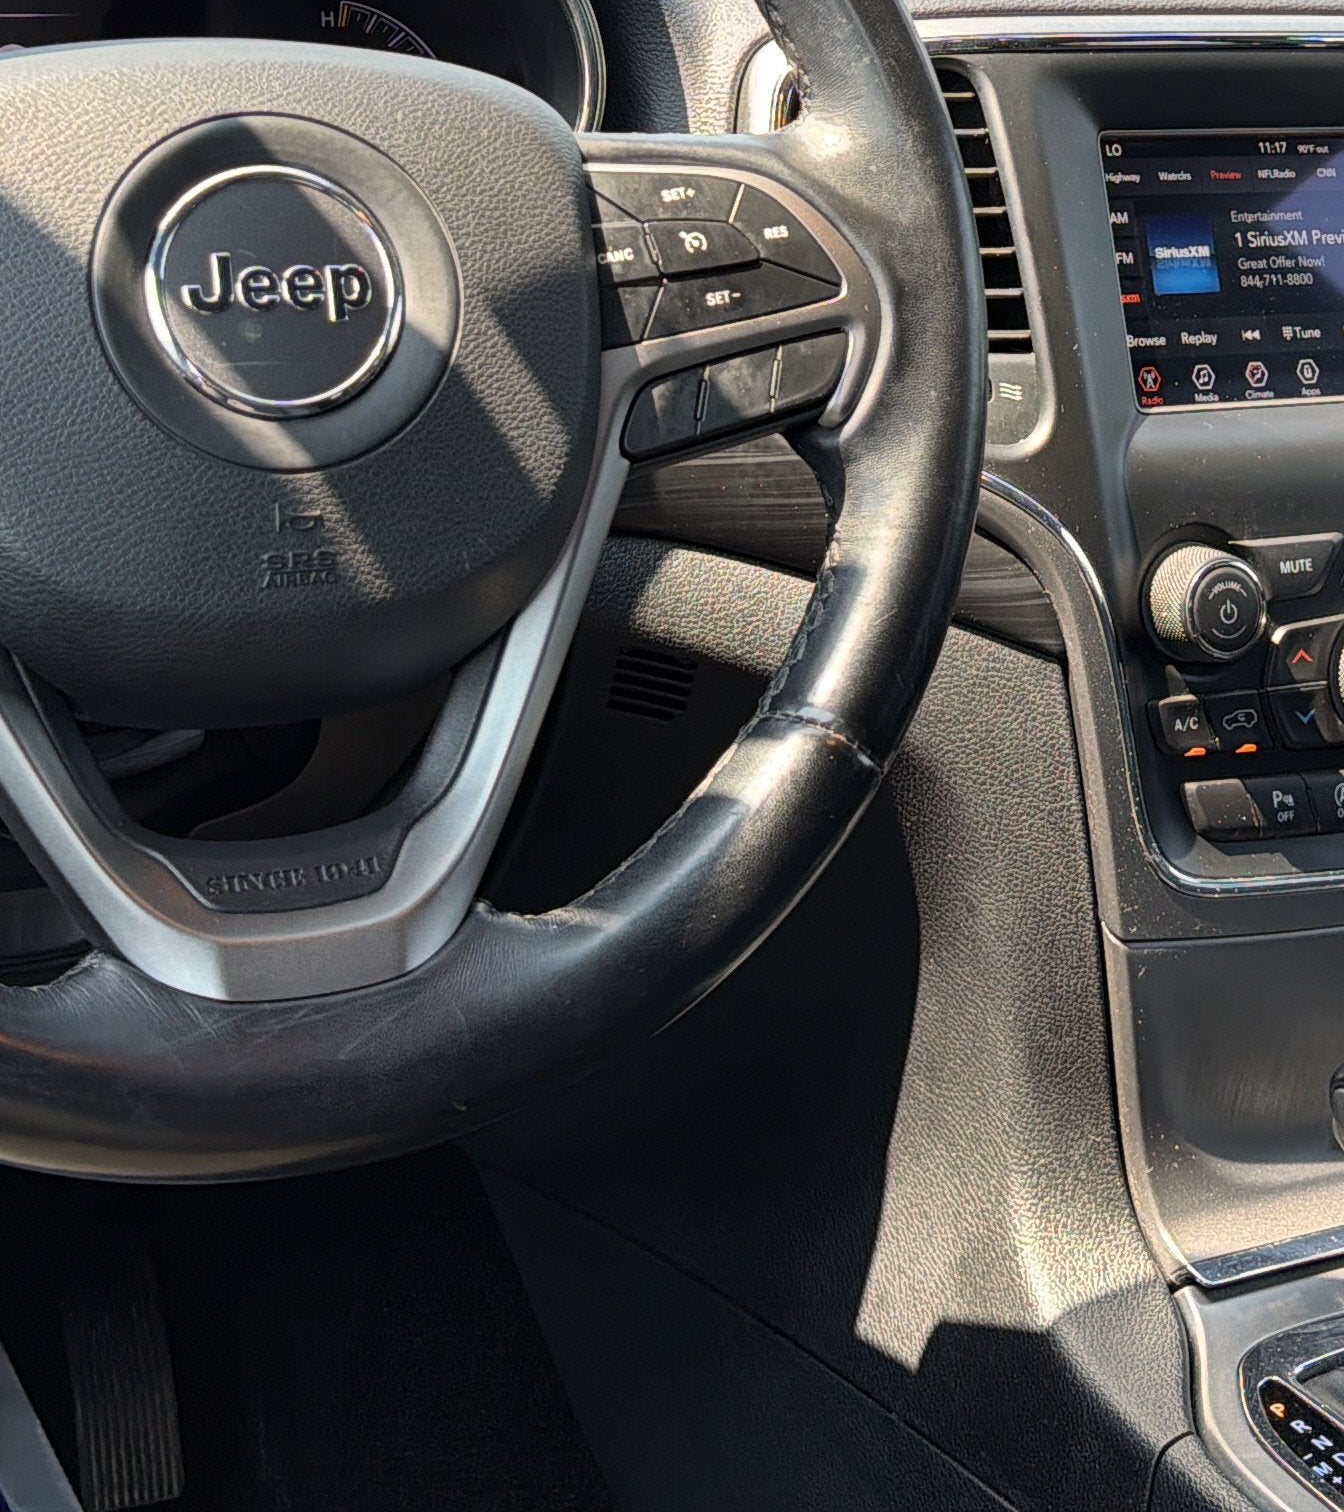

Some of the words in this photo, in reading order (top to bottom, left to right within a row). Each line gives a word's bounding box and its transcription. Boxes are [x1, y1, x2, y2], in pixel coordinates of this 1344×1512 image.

[320, 11, 335, 28] H
[1106, 143, 1122, 157] LO
[1258, 141, 1287, 154] 11:17
[1106, 171, 1141, 184] Highway
[1210, 170, 1243, 180] Preview
[1316, 167, 1336, 178] CNN
[1109, 211, 1129, 224] AM
[1230, 210, 1304, 224] Entertainment
[763, 225, 790, 240] RES
[1234, 232, 1243, 248] 1
[1247, 230, 1308, 248] SiriusXM
[597, 247, 635, 265] CANC
[1115, 252, 1134, 264] FM
[1154, 245, 1210, 259] SiriusXM
[1238, 257, 1268, 271] Great
[1269, 256, 1297, 268] Offer
[1298, 255, 1326, 268] Now!
[1240, 272, 1314, 288] 844-711-8800
[180, 251, 373, 324] Jeep
[1181, 330, 1218, 347] Replay
[1294, 326, 1322, 339] Tune
[1126, 335, 1167, 348] Browse
[1141, 396, 1164, 406] Radio
[1194, 393, 1219, 402] Media
[1245, 390, 1275, 400] Climate
[1279, 558, 1313, 575] MUTE
[1211, 579, 1243, 594] VOLUME
[1174, 716, 1199, 732] A/C
[1277, 810, 1295, 822] OFF
[1269, 1403, 1285, 1418] P
[1289, 1419, 1313, 1434] R
[1310, 1434, 1334, 1450] N
[1311, 1461, 1334, 1477] M
